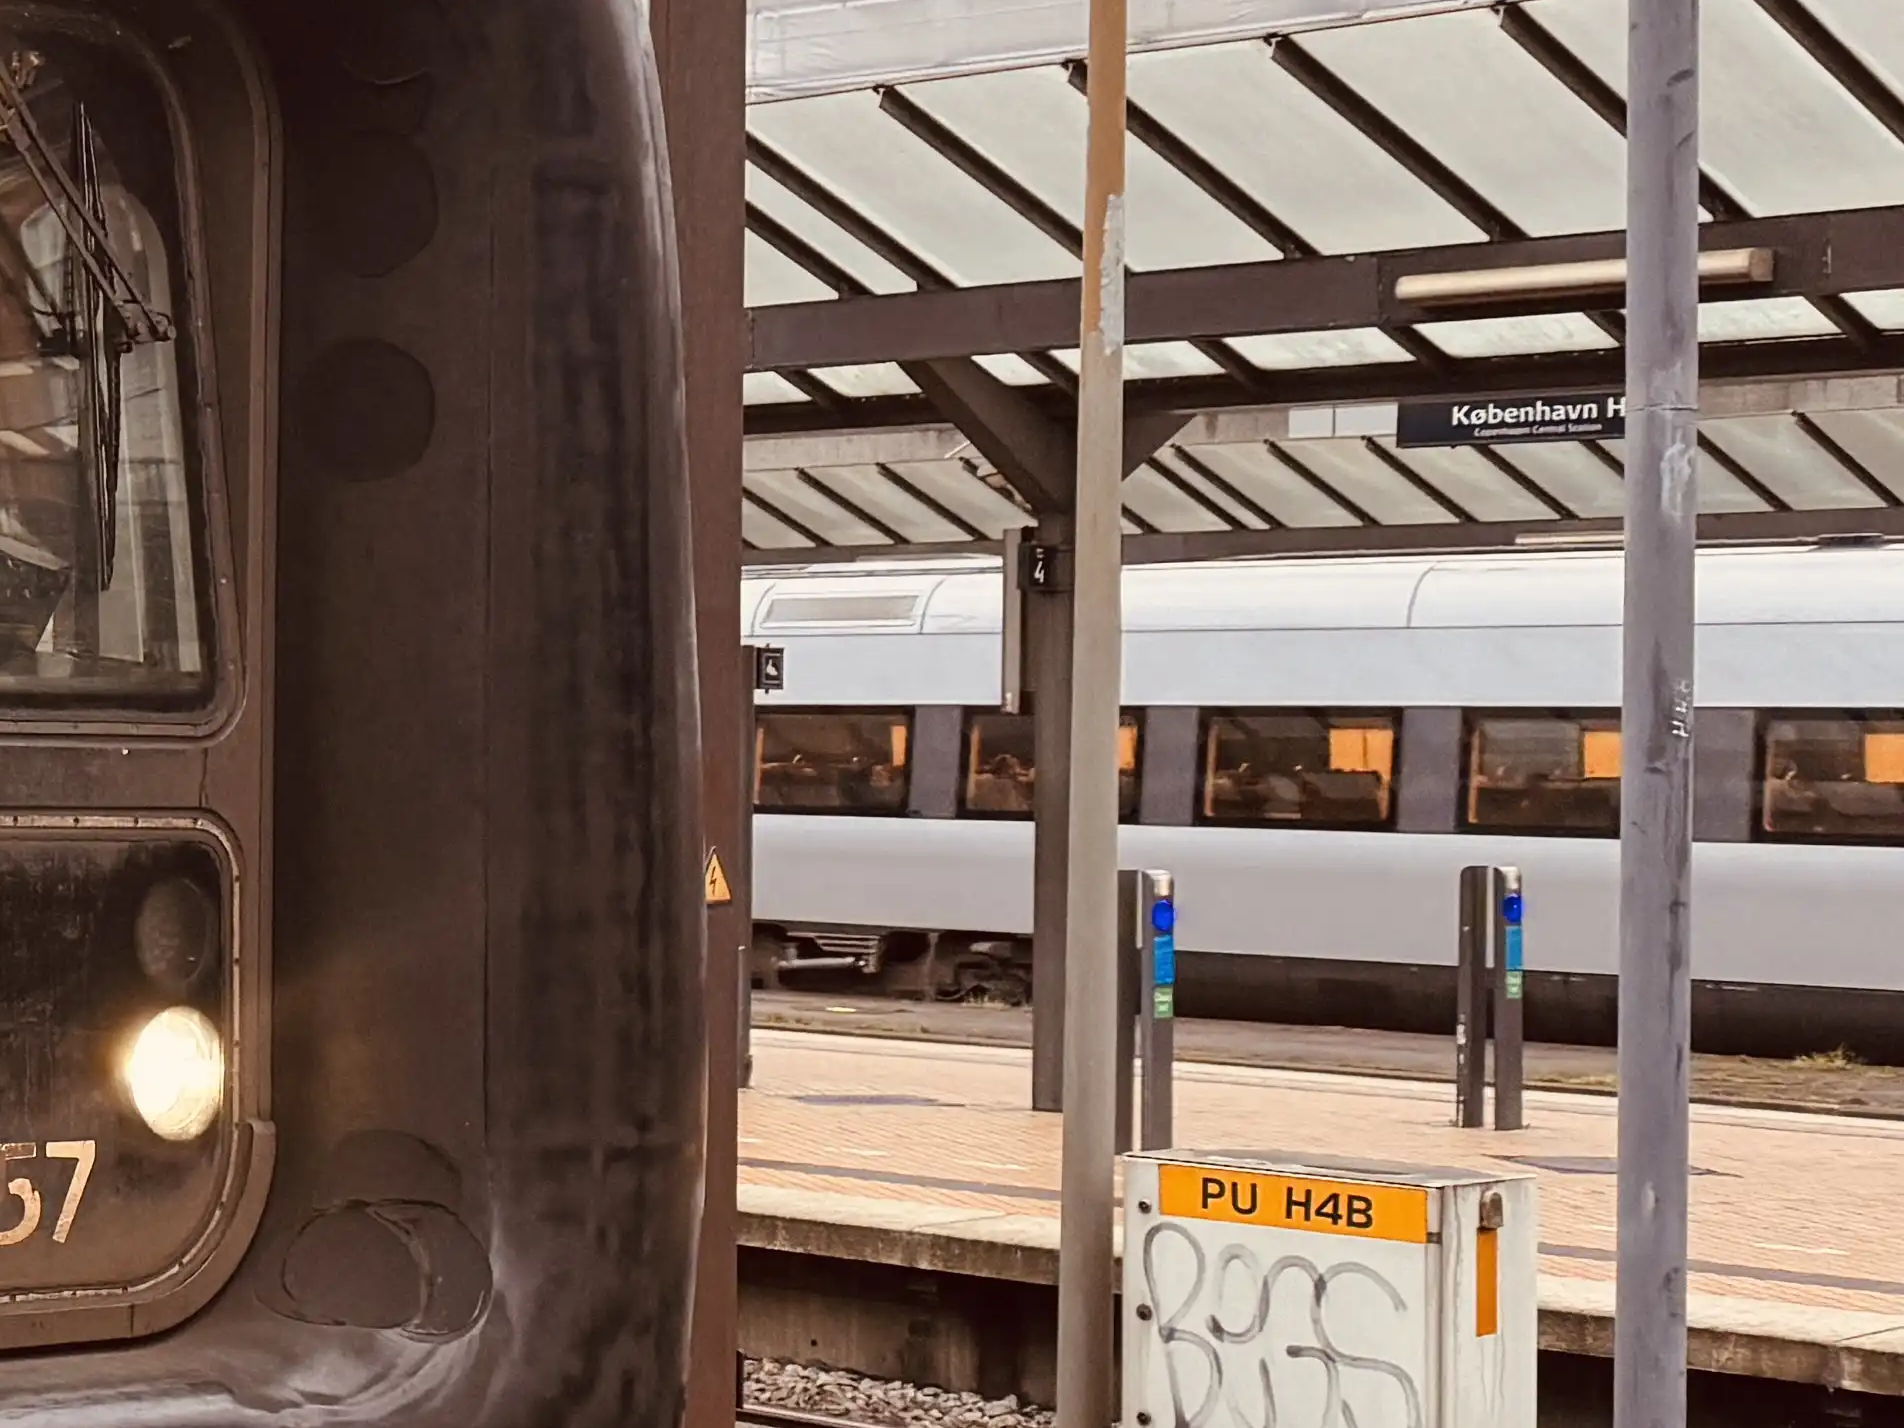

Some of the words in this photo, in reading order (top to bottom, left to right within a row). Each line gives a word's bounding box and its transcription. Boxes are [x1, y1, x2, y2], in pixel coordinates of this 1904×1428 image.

[1451, 400, 1598, 426] København
[1201, 1176, 1258, 1215] PU
[1285, 1185, 1374, 1229] H4B
